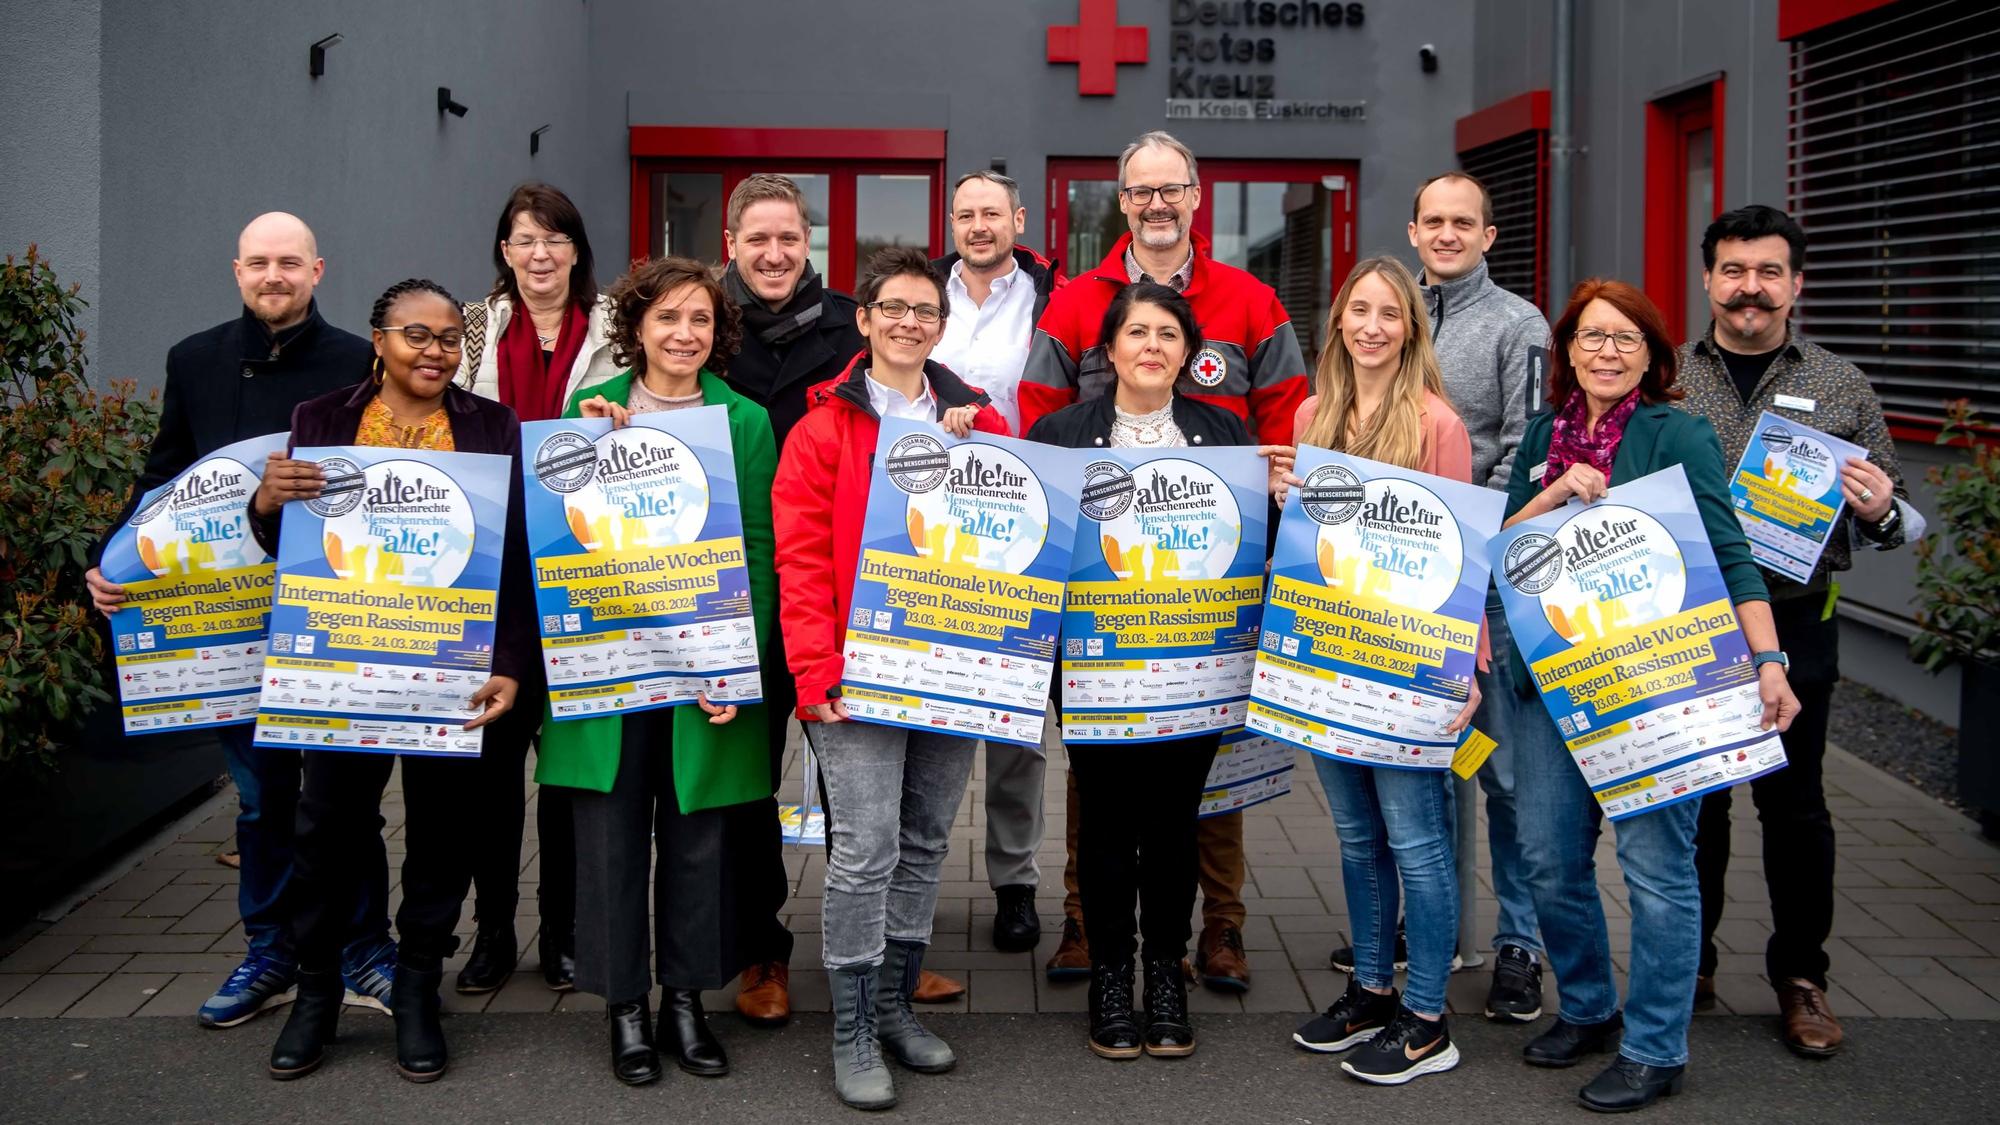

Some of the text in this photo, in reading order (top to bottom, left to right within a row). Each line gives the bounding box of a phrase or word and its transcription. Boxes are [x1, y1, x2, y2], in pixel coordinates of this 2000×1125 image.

[1170, 0, 1365, 27] Deutsches
[1170, 31, 1276, 63] Rotes
[1170, 67, 1275, 98] Kreuz
[1168, 100, 1364, 118] im Kreis Euskirchen
[1193, 352, 1222, 366] DEUTSCHES
[1193, 368, 1224, 384] ROTES KREUZ
[596, 462, 680, 484] Menschenrechte
[599, 439, 675, 478] alle! für
[903, 456, 948, 468] MENSCHENWÜRDE
[949, 450, 1027, 488] alle! für
[173, 471, 242, 504] alle! für
[367, 468, 424, 506] alle!
[423, 485, 450, 500] für
[598, 475, 682, 495] Menschenrechte
[944, 483, 1028, 501] Menschenrechte
[1089, 480, 1133, 496] MENSCHENWÜRDE
[1137, 468, 1214, 507] alle! für
[1318, 490, 1363, 498] MENSCHENWÜRDE
[168, 500, 248, 522] Menschenrechte
[169, 488, 247, 512] Menschenrechte
[362, 502, 451, 514] Menschenrechte
[607, 491, 676, 519] für alle!
[943, 493, 1026, 514] Menschenrechte
[1133, 498, 1217, 515] Menschenrechte
[1362, 486, 1443, 526] alle! für
[176, 516, 242, 544] für alle!
[361, 513, 449, 527] Menschenrechte
[948, 503, 1015, 543] für alle!
[1134, 511, 1217, 525] Menschenrechte
[1357, 517, 1442, 540] Menschenrechte
[368, 523, 440, 557] für alle!
[1142, 521, 1208, 550] für alle!
[1354, 527, 1439, 553] Menschenrechte
[1564, 518, 1638, 567] alle! für
[537, 549, 741, 582] Internationale Wochen
[1360, 537, 1427, 580] für alle!
[1565, 533, 1647, 575] Menschenrechte
[1569, 546, 1651, 584] Menschenrechte
[125, 570, 276, 602] ternationale Woc
[568, 575, 716, 606] gegen Rassismus
[862, 558, 1060, 607] Internationale Wochen
[1067, 585, 1260, 606] Internationale Wochen
[1579, 564, 1653, 602] für alle!
[142, 596, 273, 625] gegen Rassismu
[278, 583, 492, 615] Internationale Wochen
[886, 586, 1030, 622] gegen Rassismus
[306, 609, 461, 635] gegen Rassismus
[1094, 608, 1235, 631] gegen Rassismus
[1271, 584, 1474, 647] Internationale Wochen
[1293, 615, 1442, 661] gegen Rassismus
[1535, 634, 1652, 687] Internationale
[1652, 611, 1733, 646] Wochen
[1568, 675, 1615, 703] gegen
[1616, 643, 1711, 683] Rassismus
